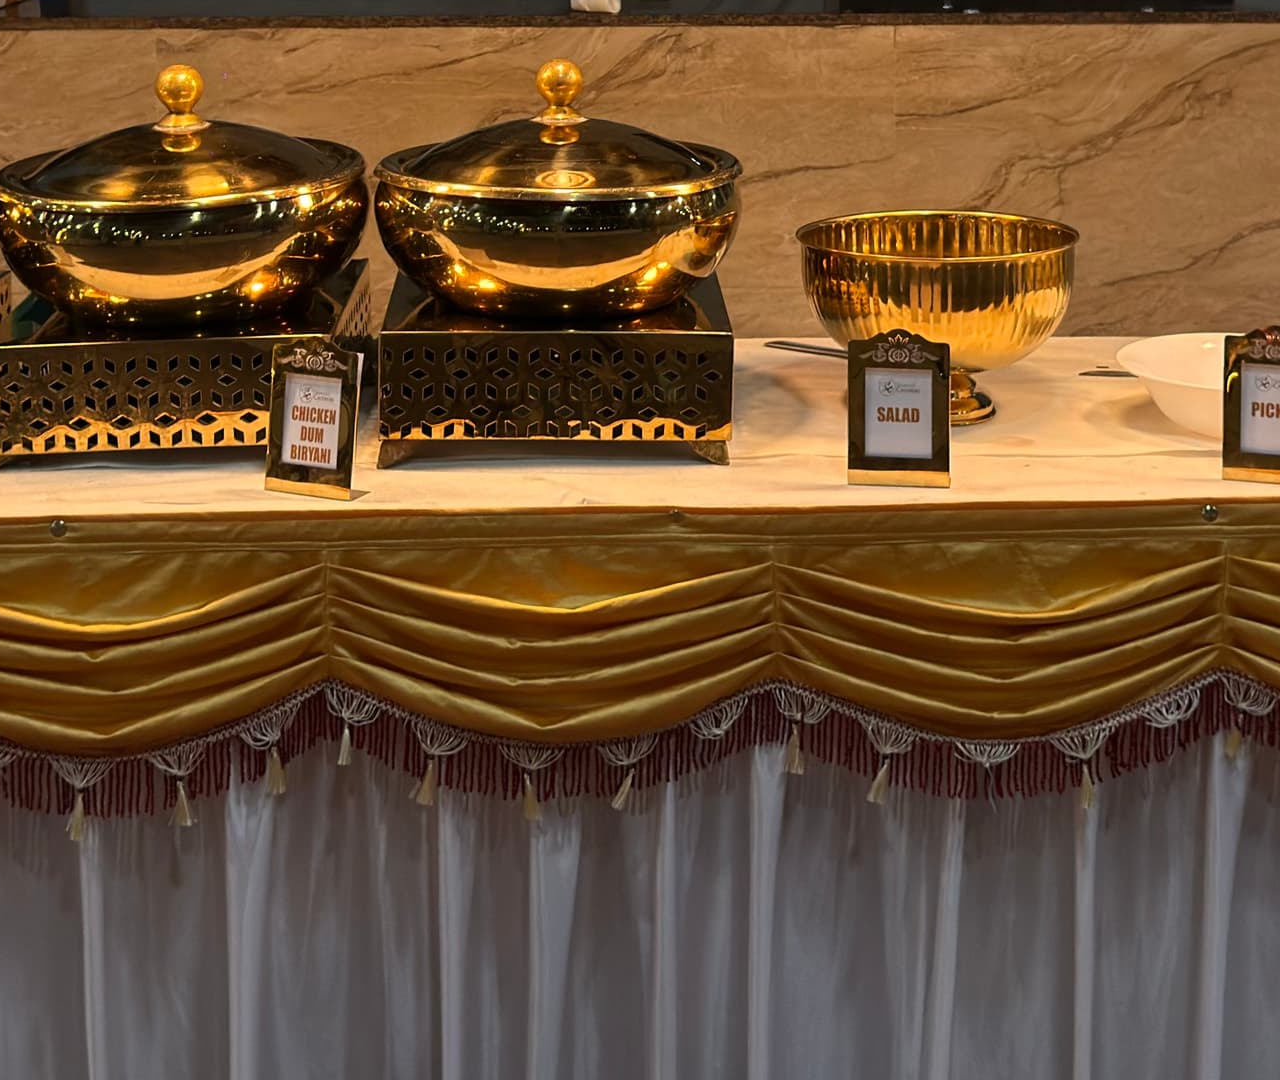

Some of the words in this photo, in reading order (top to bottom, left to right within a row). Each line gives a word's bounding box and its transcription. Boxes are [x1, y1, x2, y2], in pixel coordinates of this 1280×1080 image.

[292, 405, 336, 425] CHICKEN
[877, 406, 920, 423] SALAD
[300, 425, 324, 444] DUM
[290, 444, 332, 464] BIRYANI
